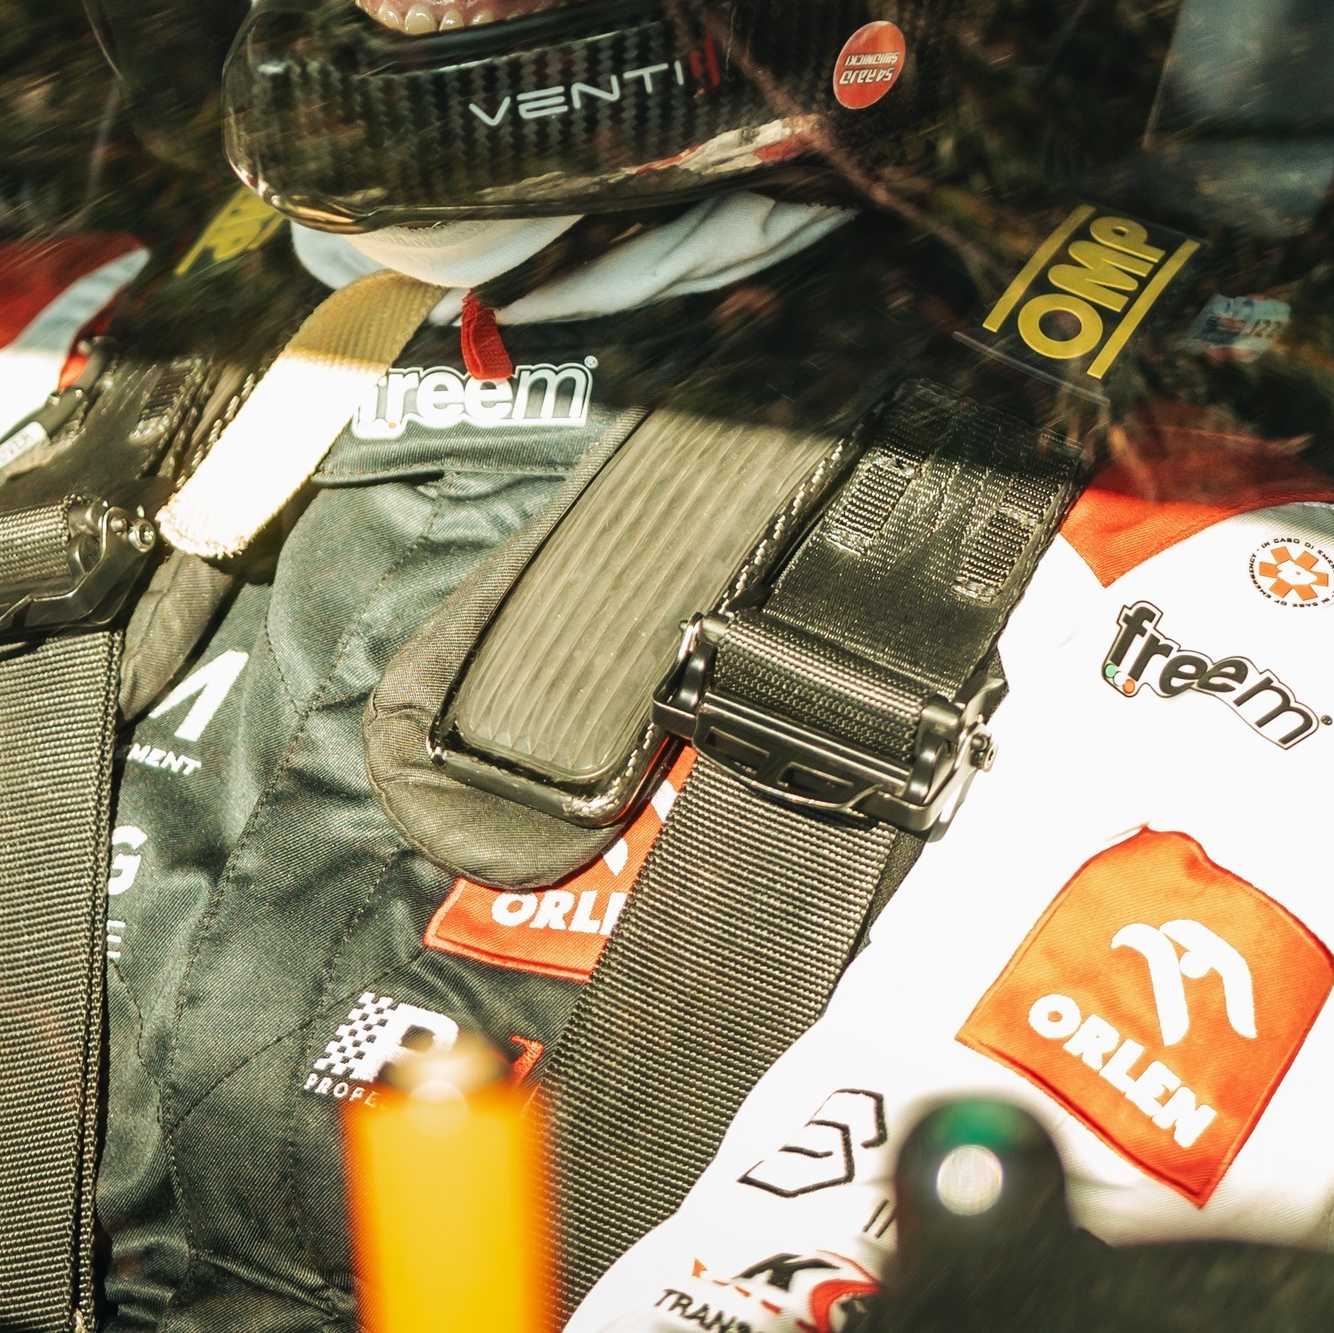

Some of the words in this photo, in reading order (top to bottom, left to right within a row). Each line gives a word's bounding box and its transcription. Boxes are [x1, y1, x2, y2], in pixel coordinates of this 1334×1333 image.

[1017, 215, 1166, 360] OMP
[1107, 604, 1316, 747] freem
[126, 742, 202, 776] MENT
[303, 1073, 383, 1109] PROFE
[1028, 993, 1216, 1149] ORLEN
